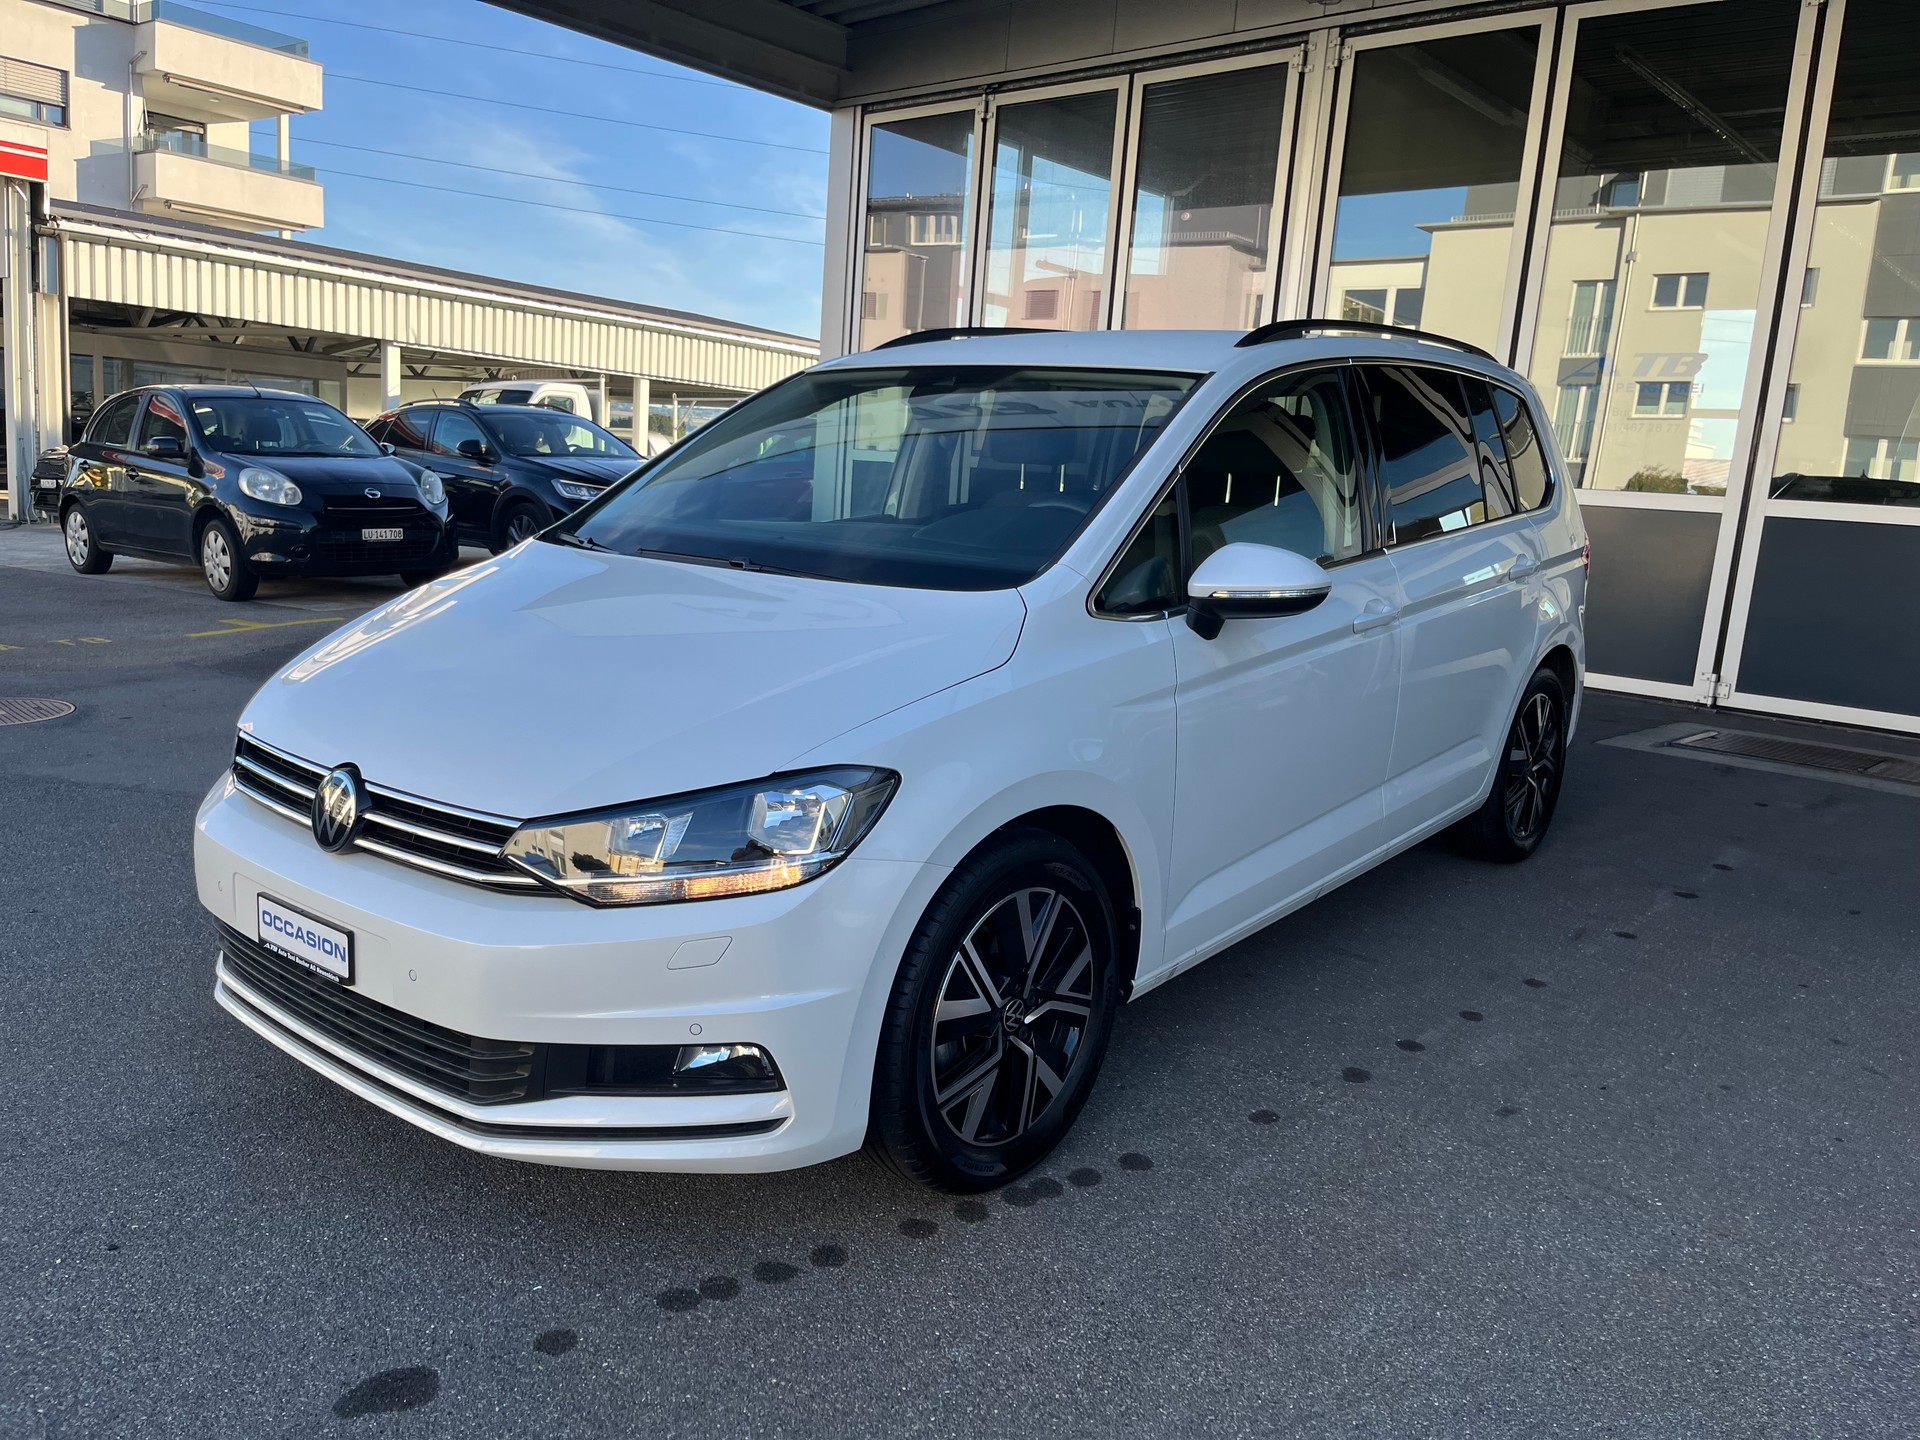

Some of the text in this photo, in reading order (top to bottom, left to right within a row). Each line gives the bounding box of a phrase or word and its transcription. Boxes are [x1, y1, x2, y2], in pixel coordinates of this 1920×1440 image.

[1557, 353, 1709, 383] ATB
[1566, 382, 1705, 394] AUTOSPENGEREI
[262, 910, 346, 962] OCCASION
[263, 942, 278, 953] ATB
